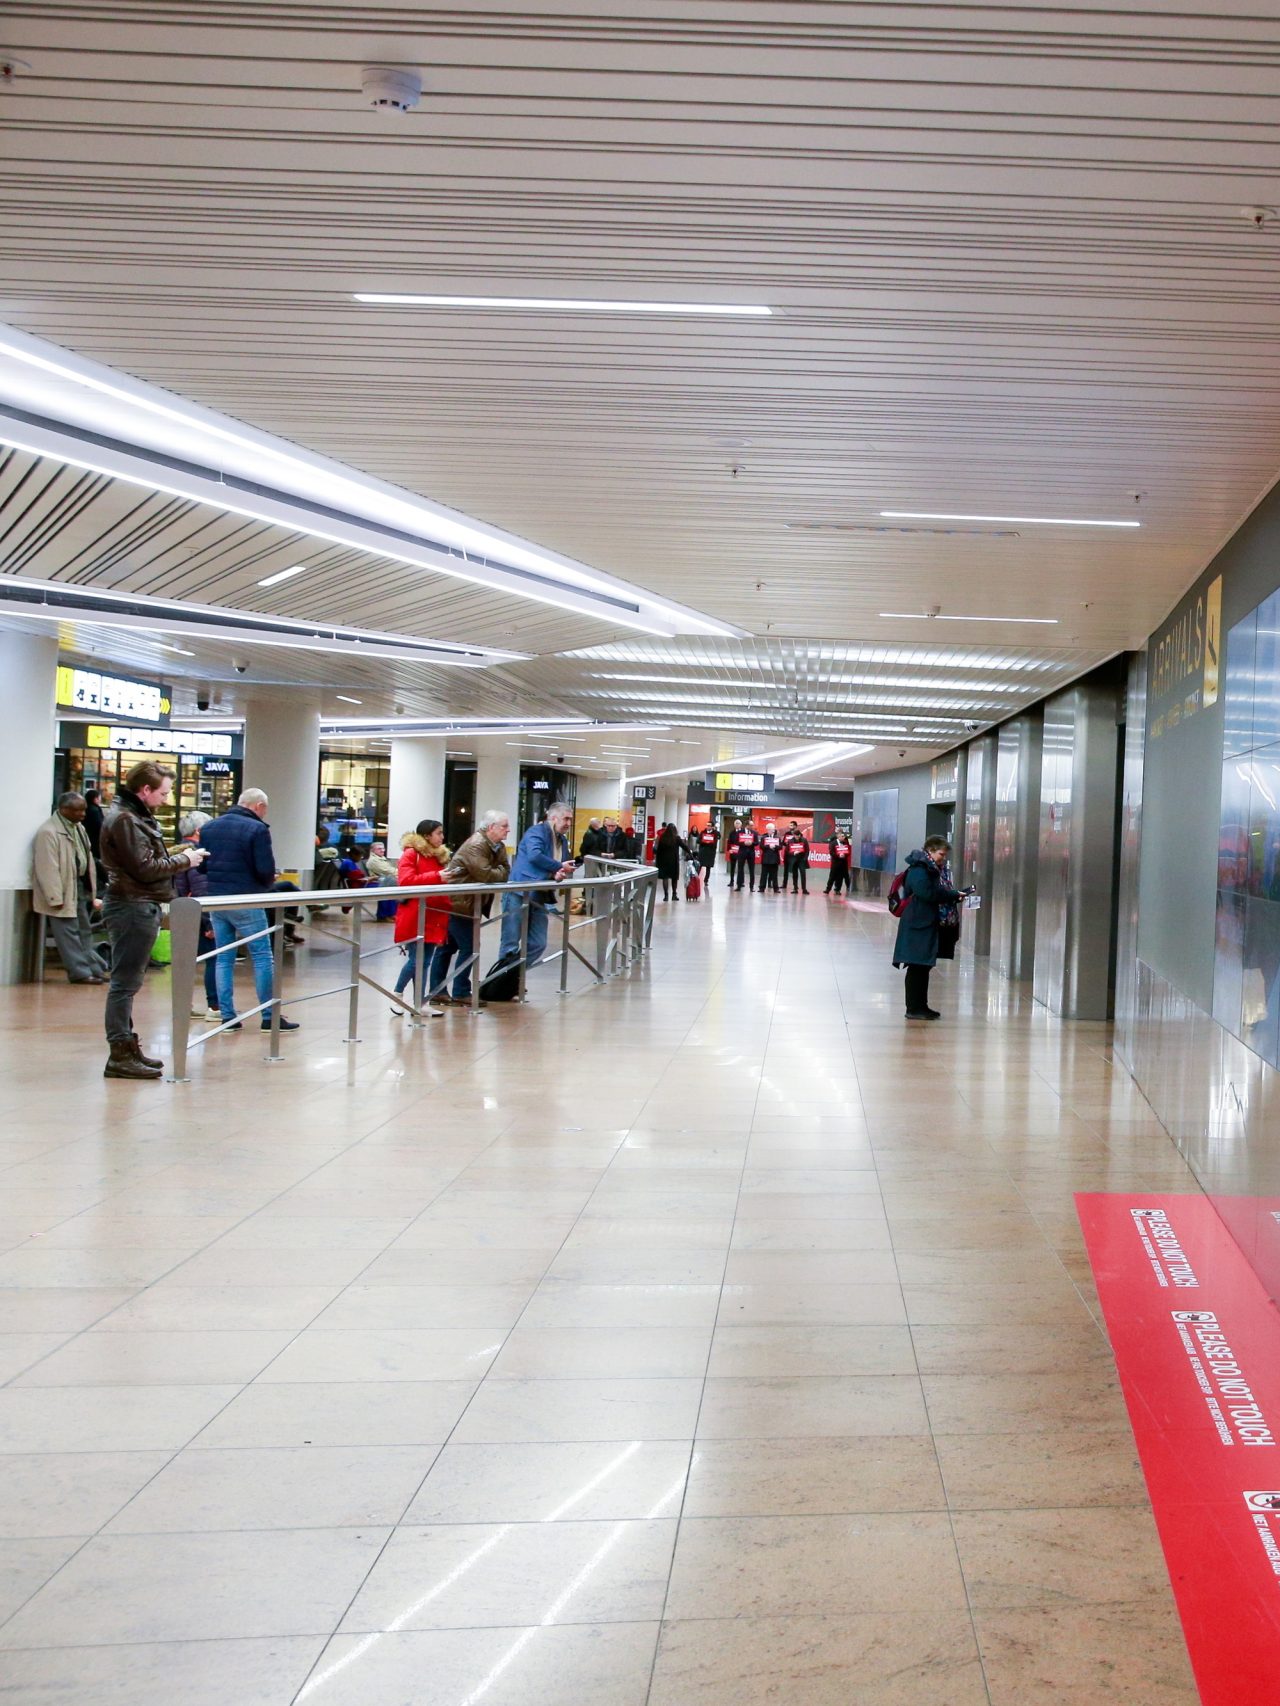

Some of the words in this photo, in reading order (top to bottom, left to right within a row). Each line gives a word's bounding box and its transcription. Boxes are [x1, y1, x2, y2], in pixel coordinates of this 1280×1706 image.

[205, 762, 230, 772] JAVA
[533, 781, 549, 790] JAVA
[728, 793, 768, 803] Information
[1146, 1216, 1176, 1239] PLEASE
[1156, 1239, 1181, 1249] DO
[1160, 1249, 1188, 1263] NOT
[1167, 1263, 1200, 1287] TOUCH
[1193, 1323, 1234, 1359] PLEASE
[1209, 1360, 1242, 1376] DO
[1216, 1378, 1254, 1401] NOT
[1228, 1402, 1276, 1446] TOUCH
